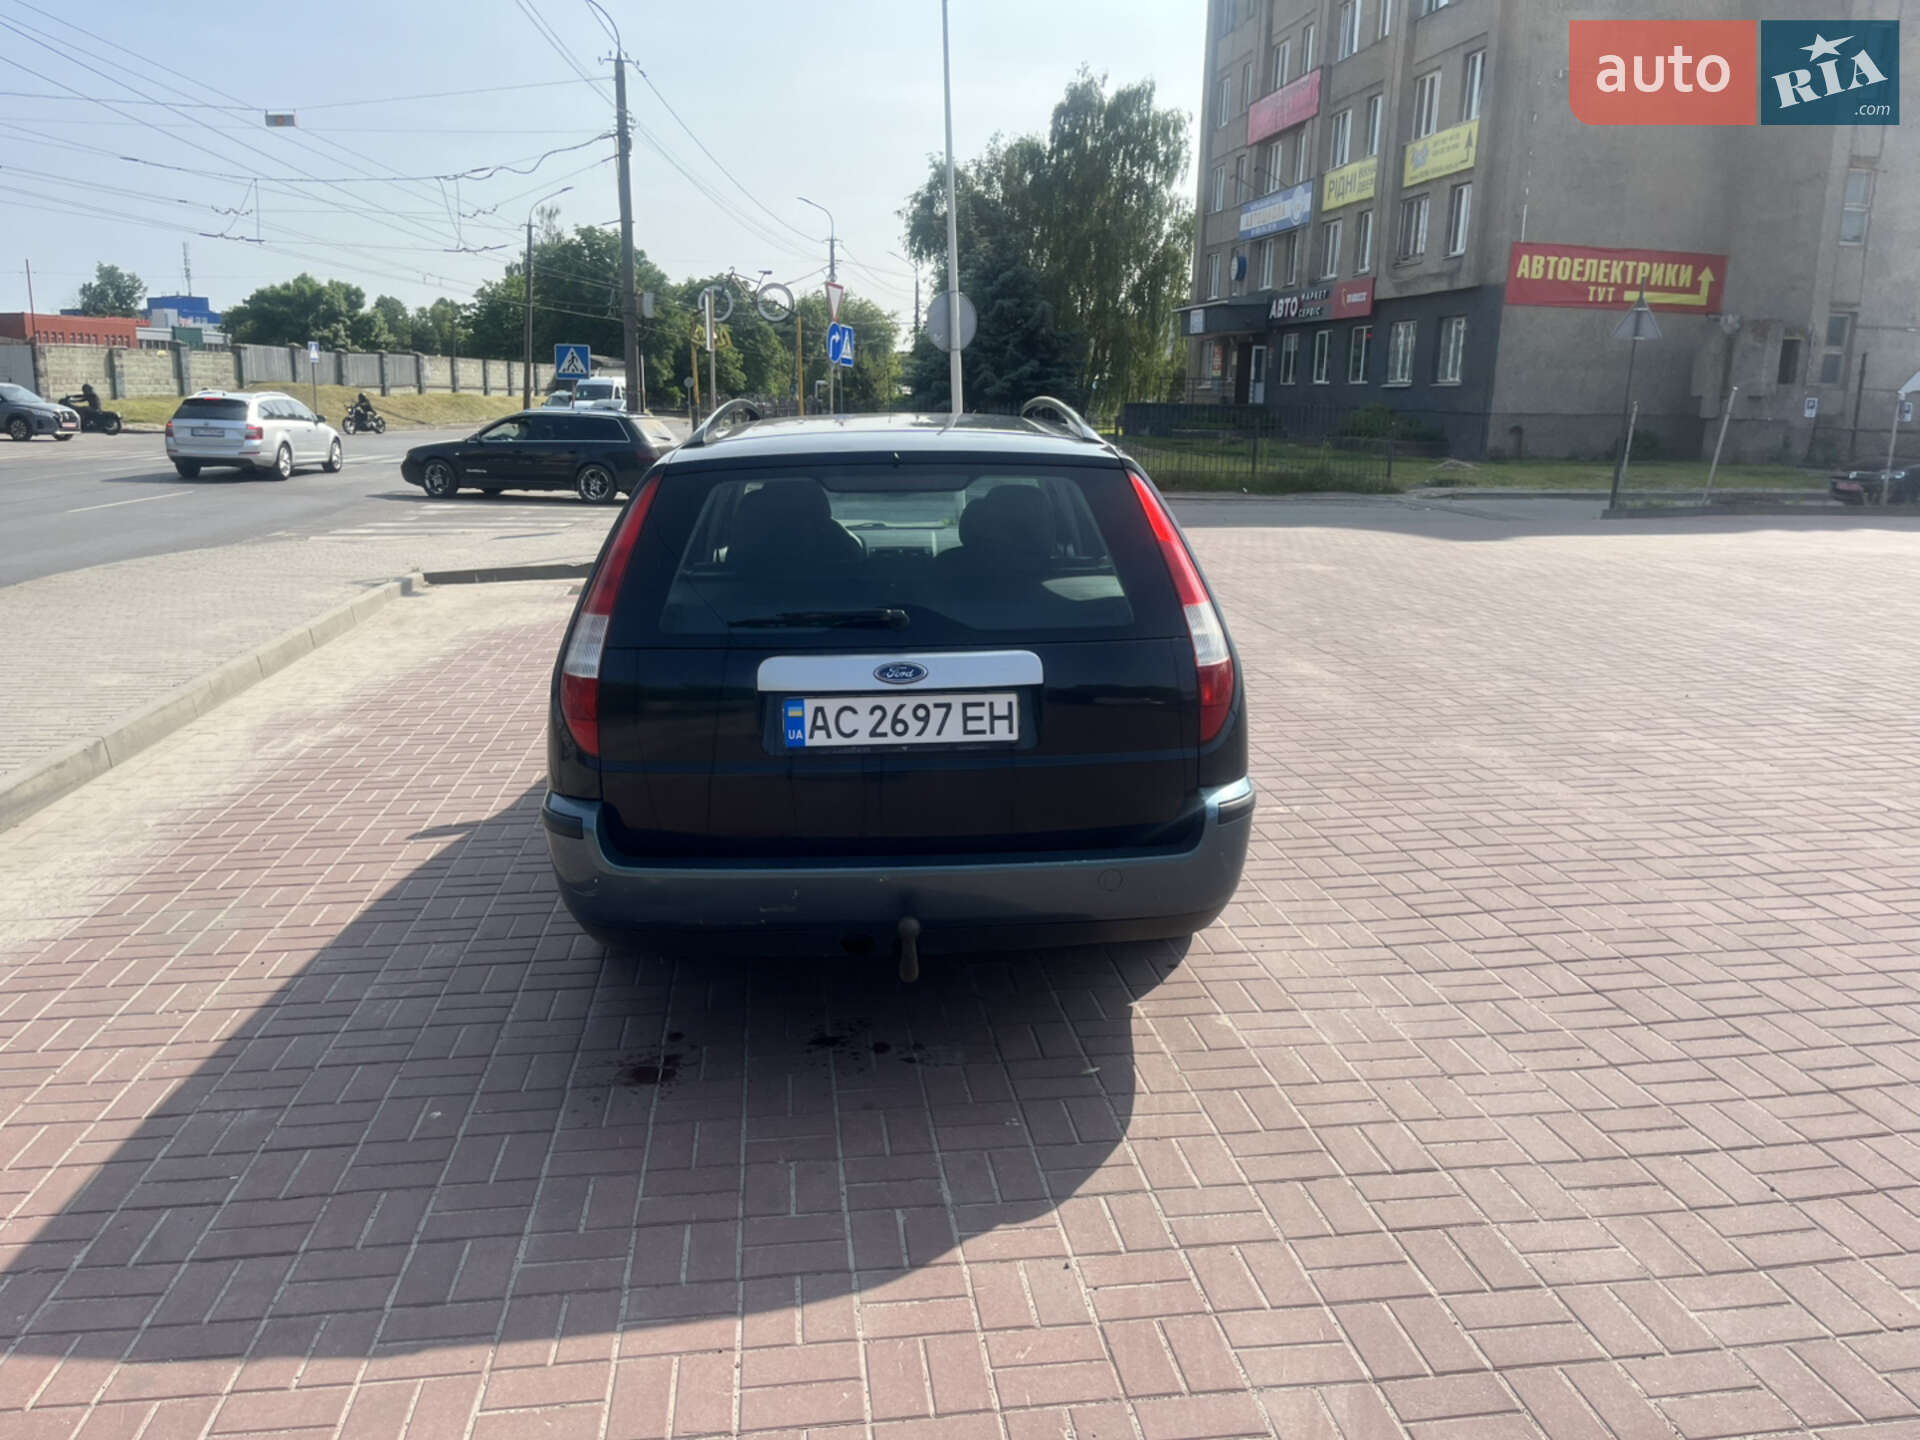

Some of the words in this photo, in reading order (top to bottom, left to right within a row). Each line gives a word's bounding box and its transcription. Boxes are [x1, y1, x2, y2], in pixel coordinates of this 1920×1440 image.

[1327, 171, 1358, 201] РІДНІ
[1516, 254, 1694, 288] АВТОЕЛЕКТРИКИ
[1588, 285, 1615, 303] ТУТ
[1269, 296, 1299, 319] АВТО
[808, 705, 859, 740] AC
[868, 702, 953, 739] 2697
[961, 701, 1014, 736] EH
[788, 729, 803, 740] UA
